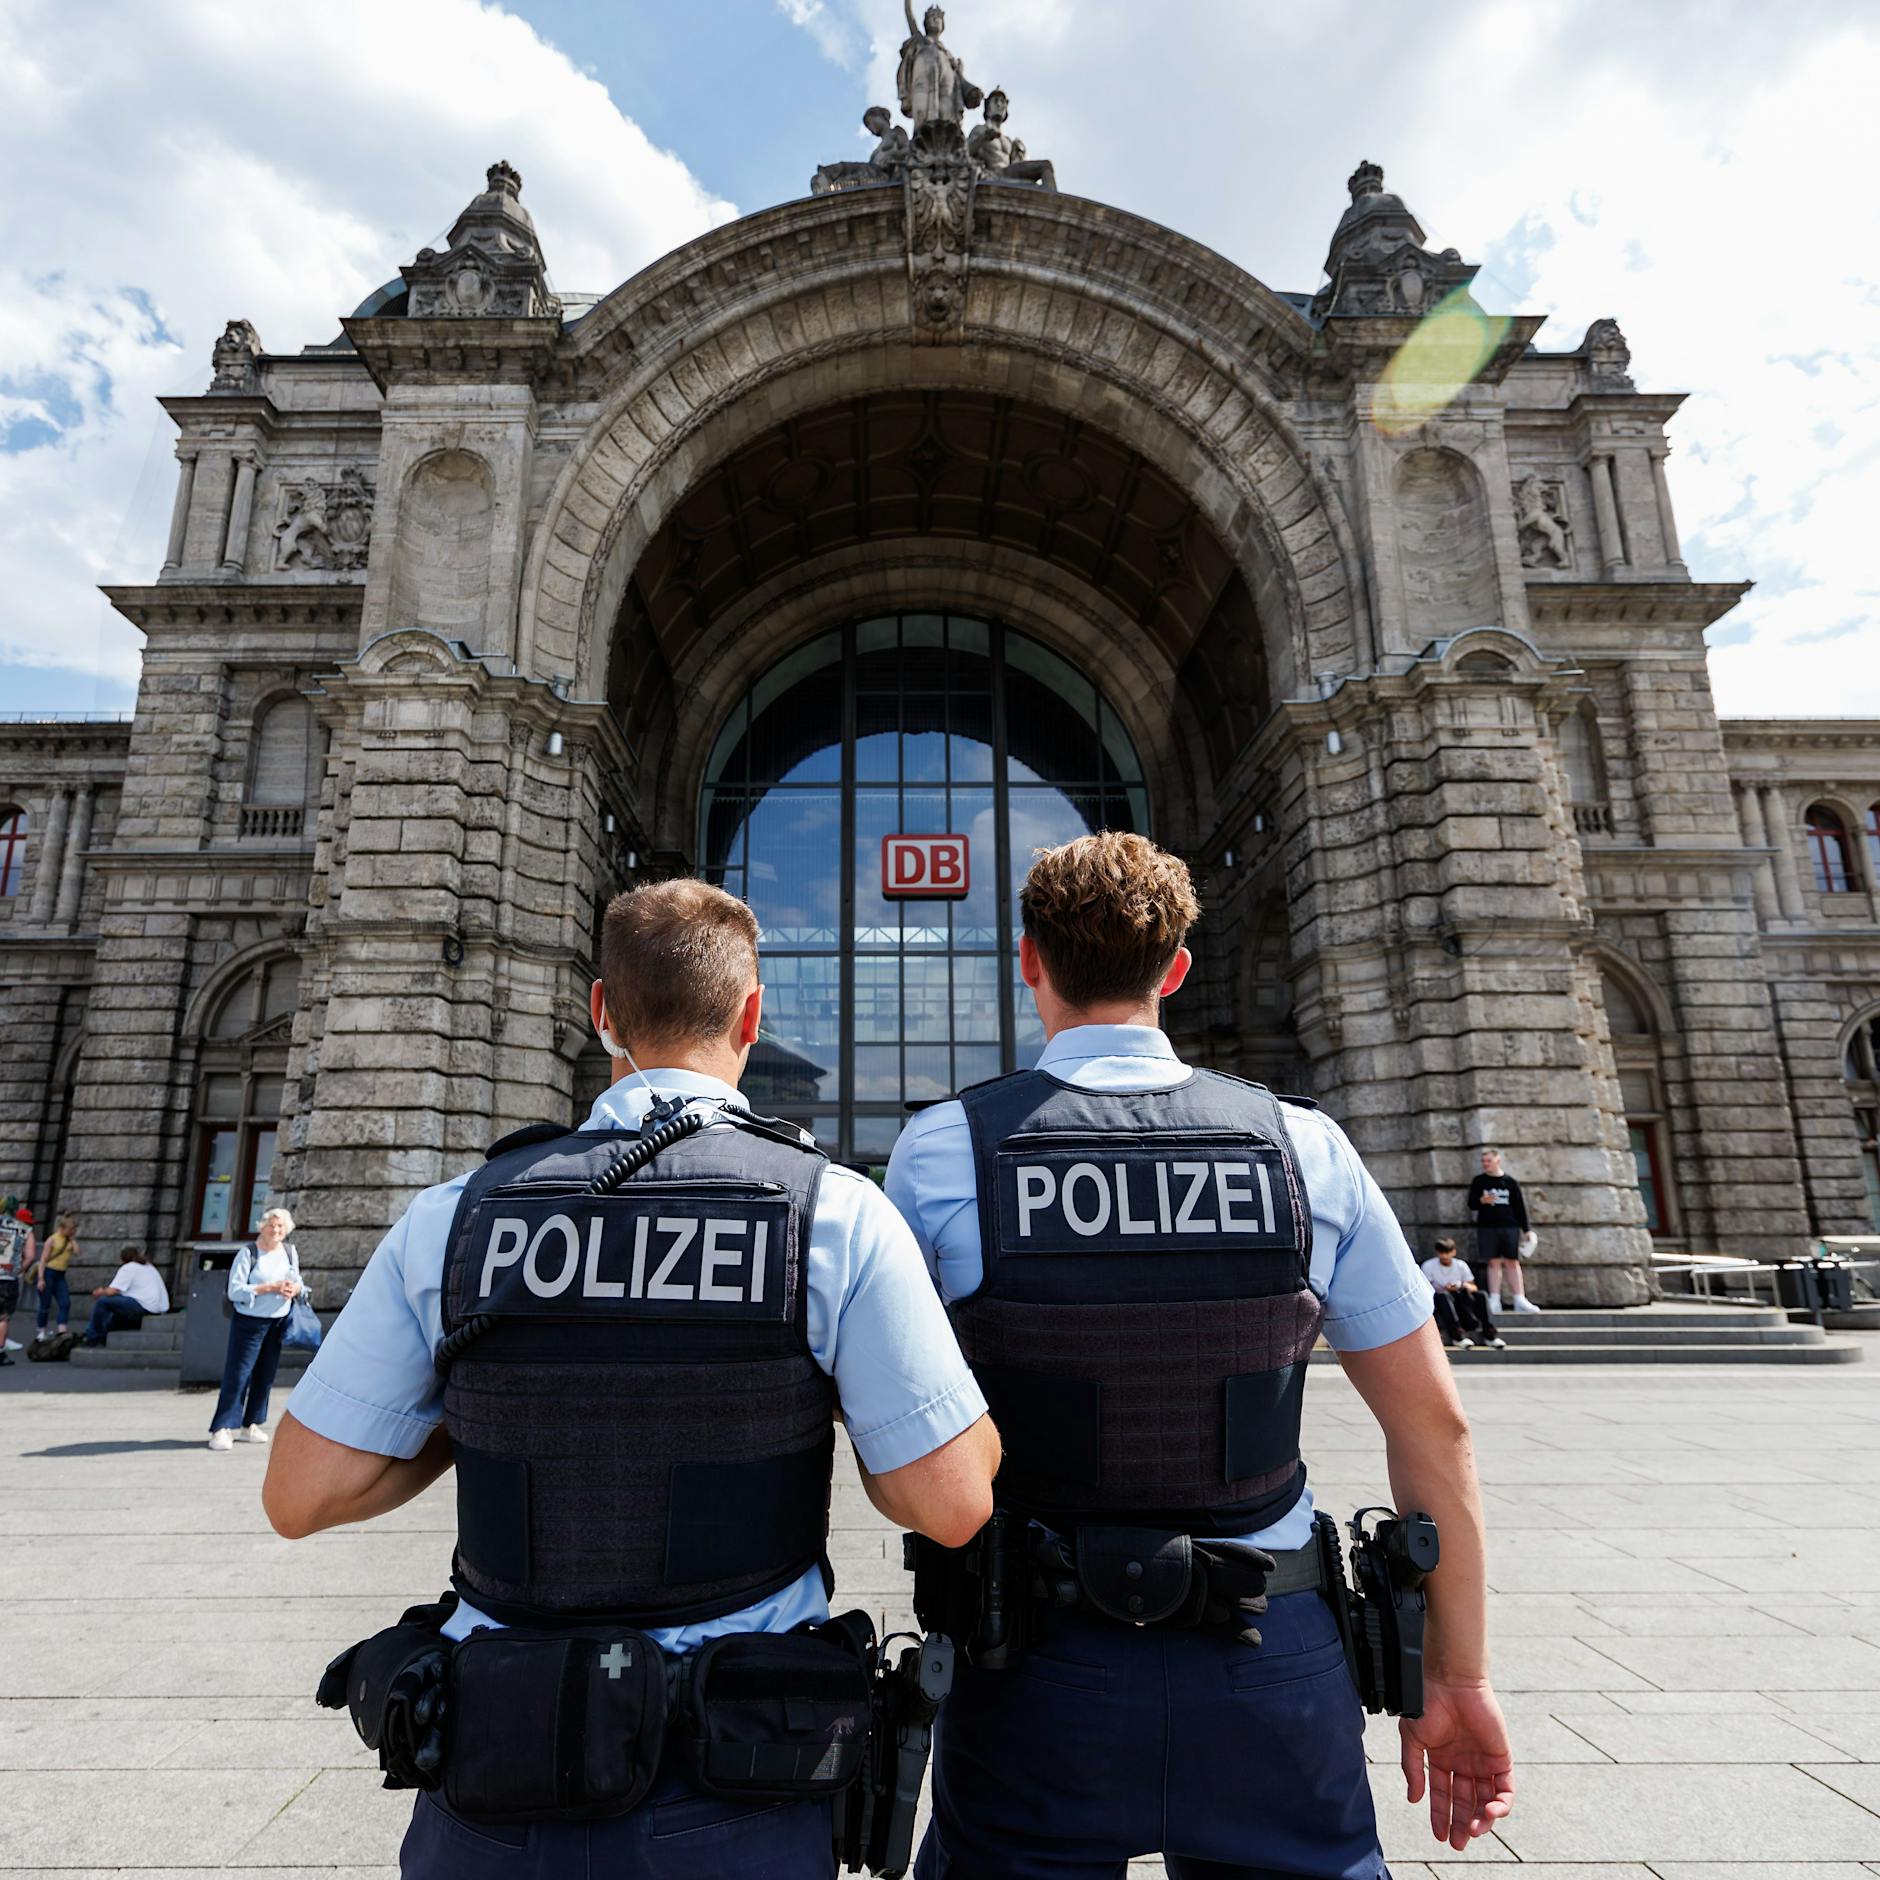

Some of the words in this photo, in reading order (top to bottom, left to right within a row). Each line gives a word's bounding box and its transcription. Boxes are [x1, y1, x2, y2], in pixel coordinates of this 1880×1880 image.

[895, 845, 961, 884] DB
[1016, 1162, 1276, 1237] POLIZEI
[479, 1214, 768, 1302] POLIZEI
